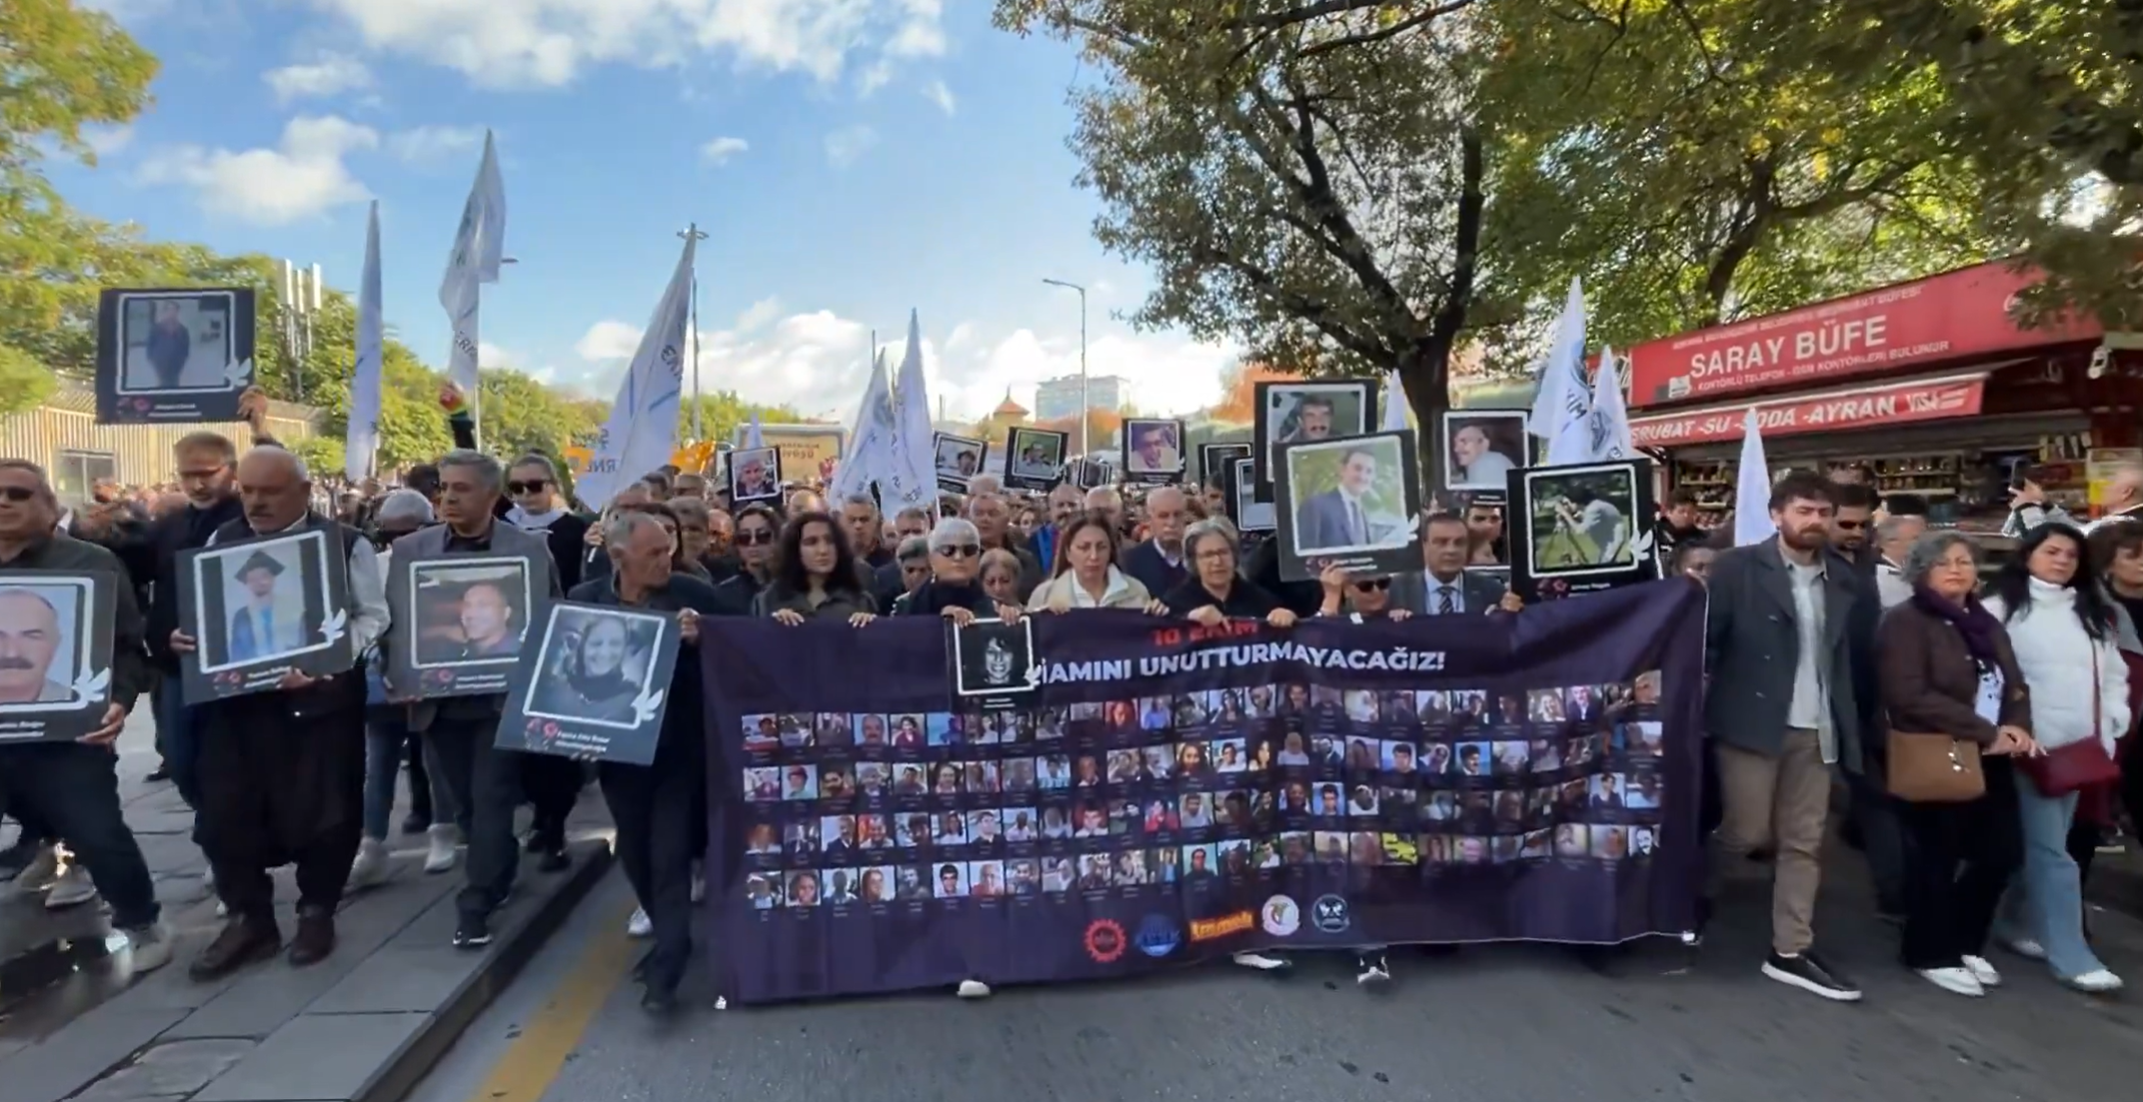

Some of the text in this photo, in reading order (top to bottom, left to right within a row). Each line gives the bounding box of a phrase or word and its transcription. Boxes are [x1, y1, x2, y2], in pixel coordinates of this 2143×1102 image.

[1690, 336, 1785, 379] SARAY
[1795, 314, 1887, 360] BÜFE
[1631, 420, 1695, 446] SRUBAT
[1040, 641, 1446, 685] İAMINI UNUTTURMAYACAĞIZ!
